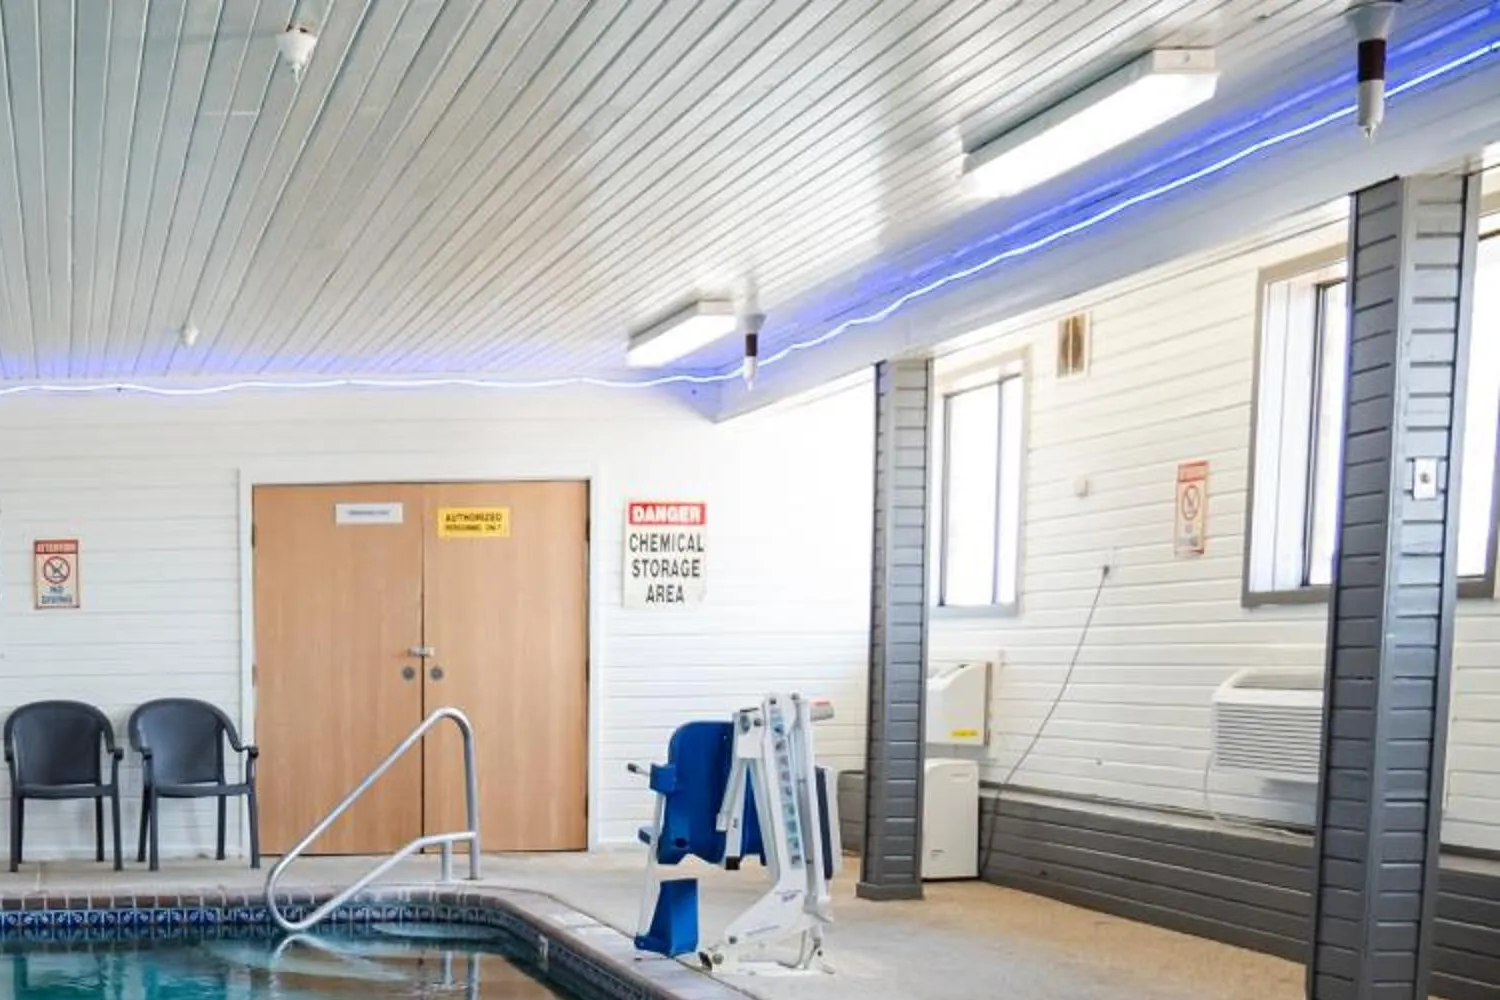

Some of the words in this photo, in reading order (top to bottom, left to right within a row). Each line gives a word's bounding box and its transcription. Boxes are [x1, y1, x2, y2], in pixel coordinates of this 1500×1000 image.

[445, 513, 502, 521] AUTHORIZED
[632, 505, 699, 523] DANGER
[629, 533, 704, 552] CHEMICAL
[632, 559, 700, 577] STORAGE
[646, 584, 684, 602] AREA
